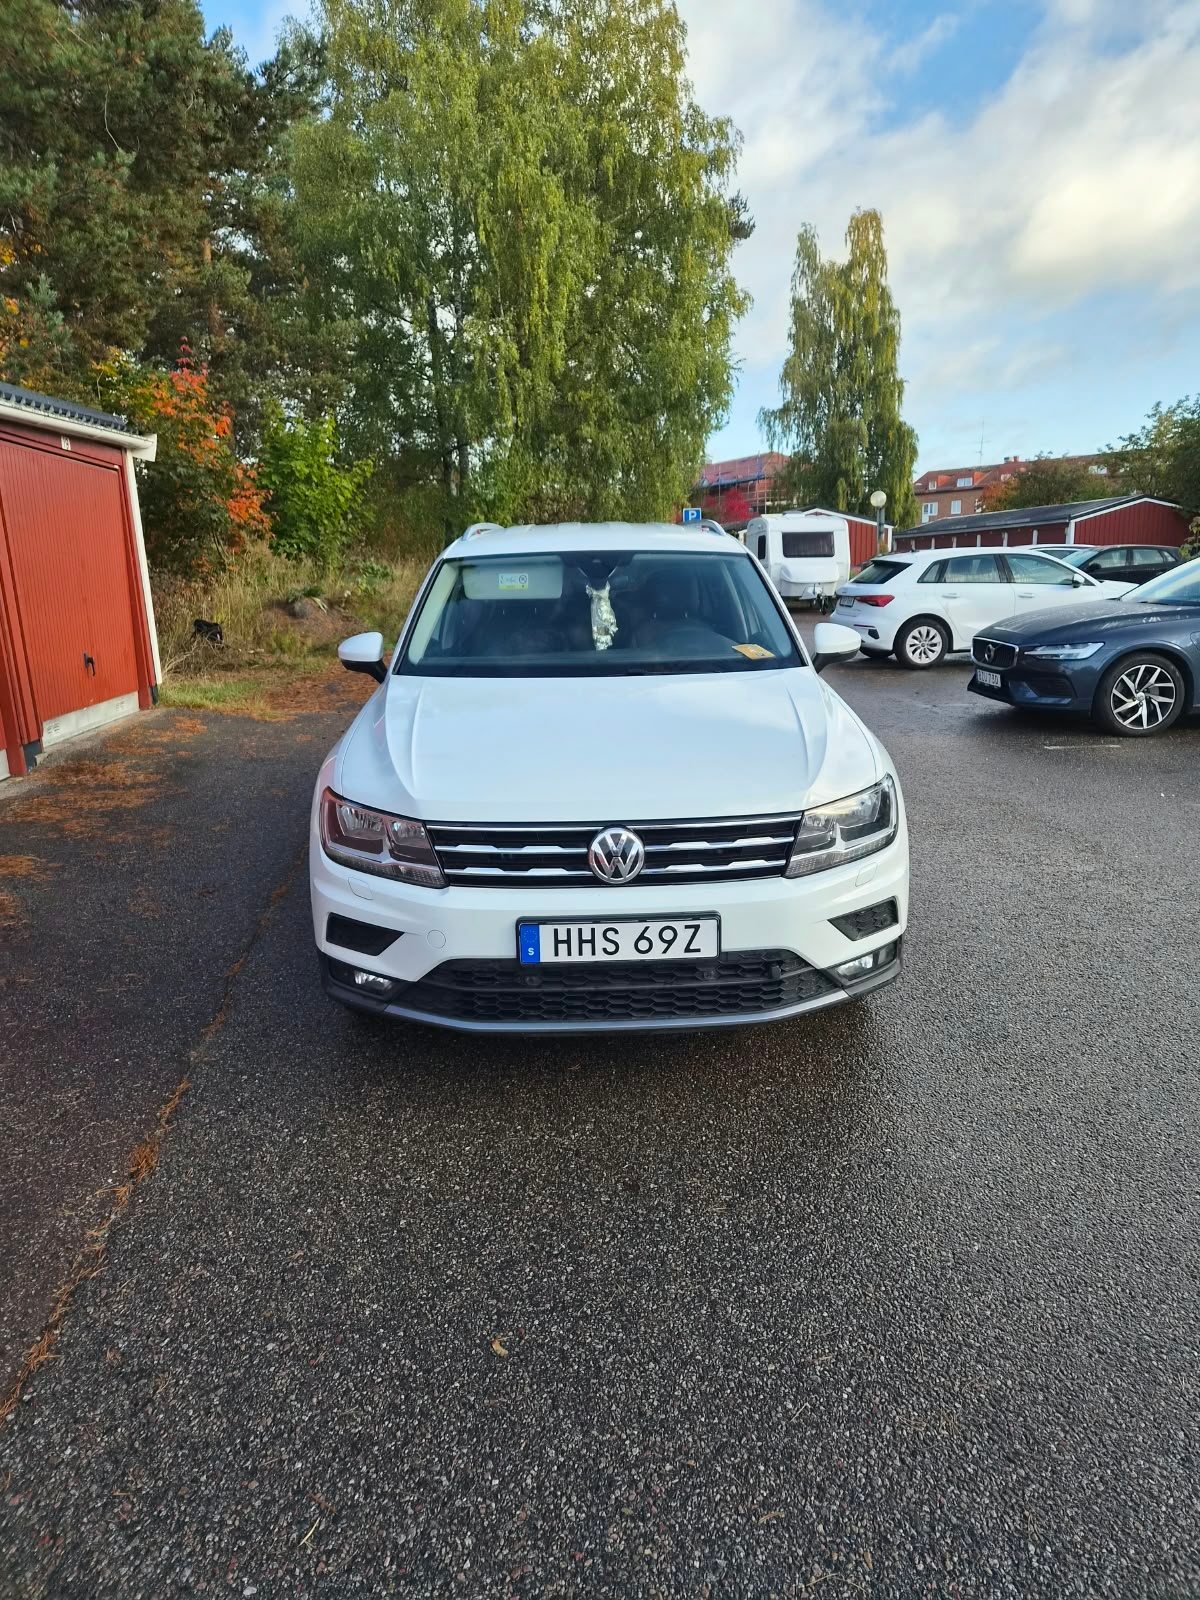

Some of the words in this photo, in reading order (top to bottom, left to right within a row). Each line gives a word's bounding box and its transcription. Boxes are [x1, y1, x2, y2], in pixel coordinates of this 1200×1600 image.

[688, 510, 697, 520] P
[591, 830, 642, 881] VW
[554, 927, 620, 957] HHS
[634, 924, 701, 955] 69Z
[528, 947, 535, 956] S
